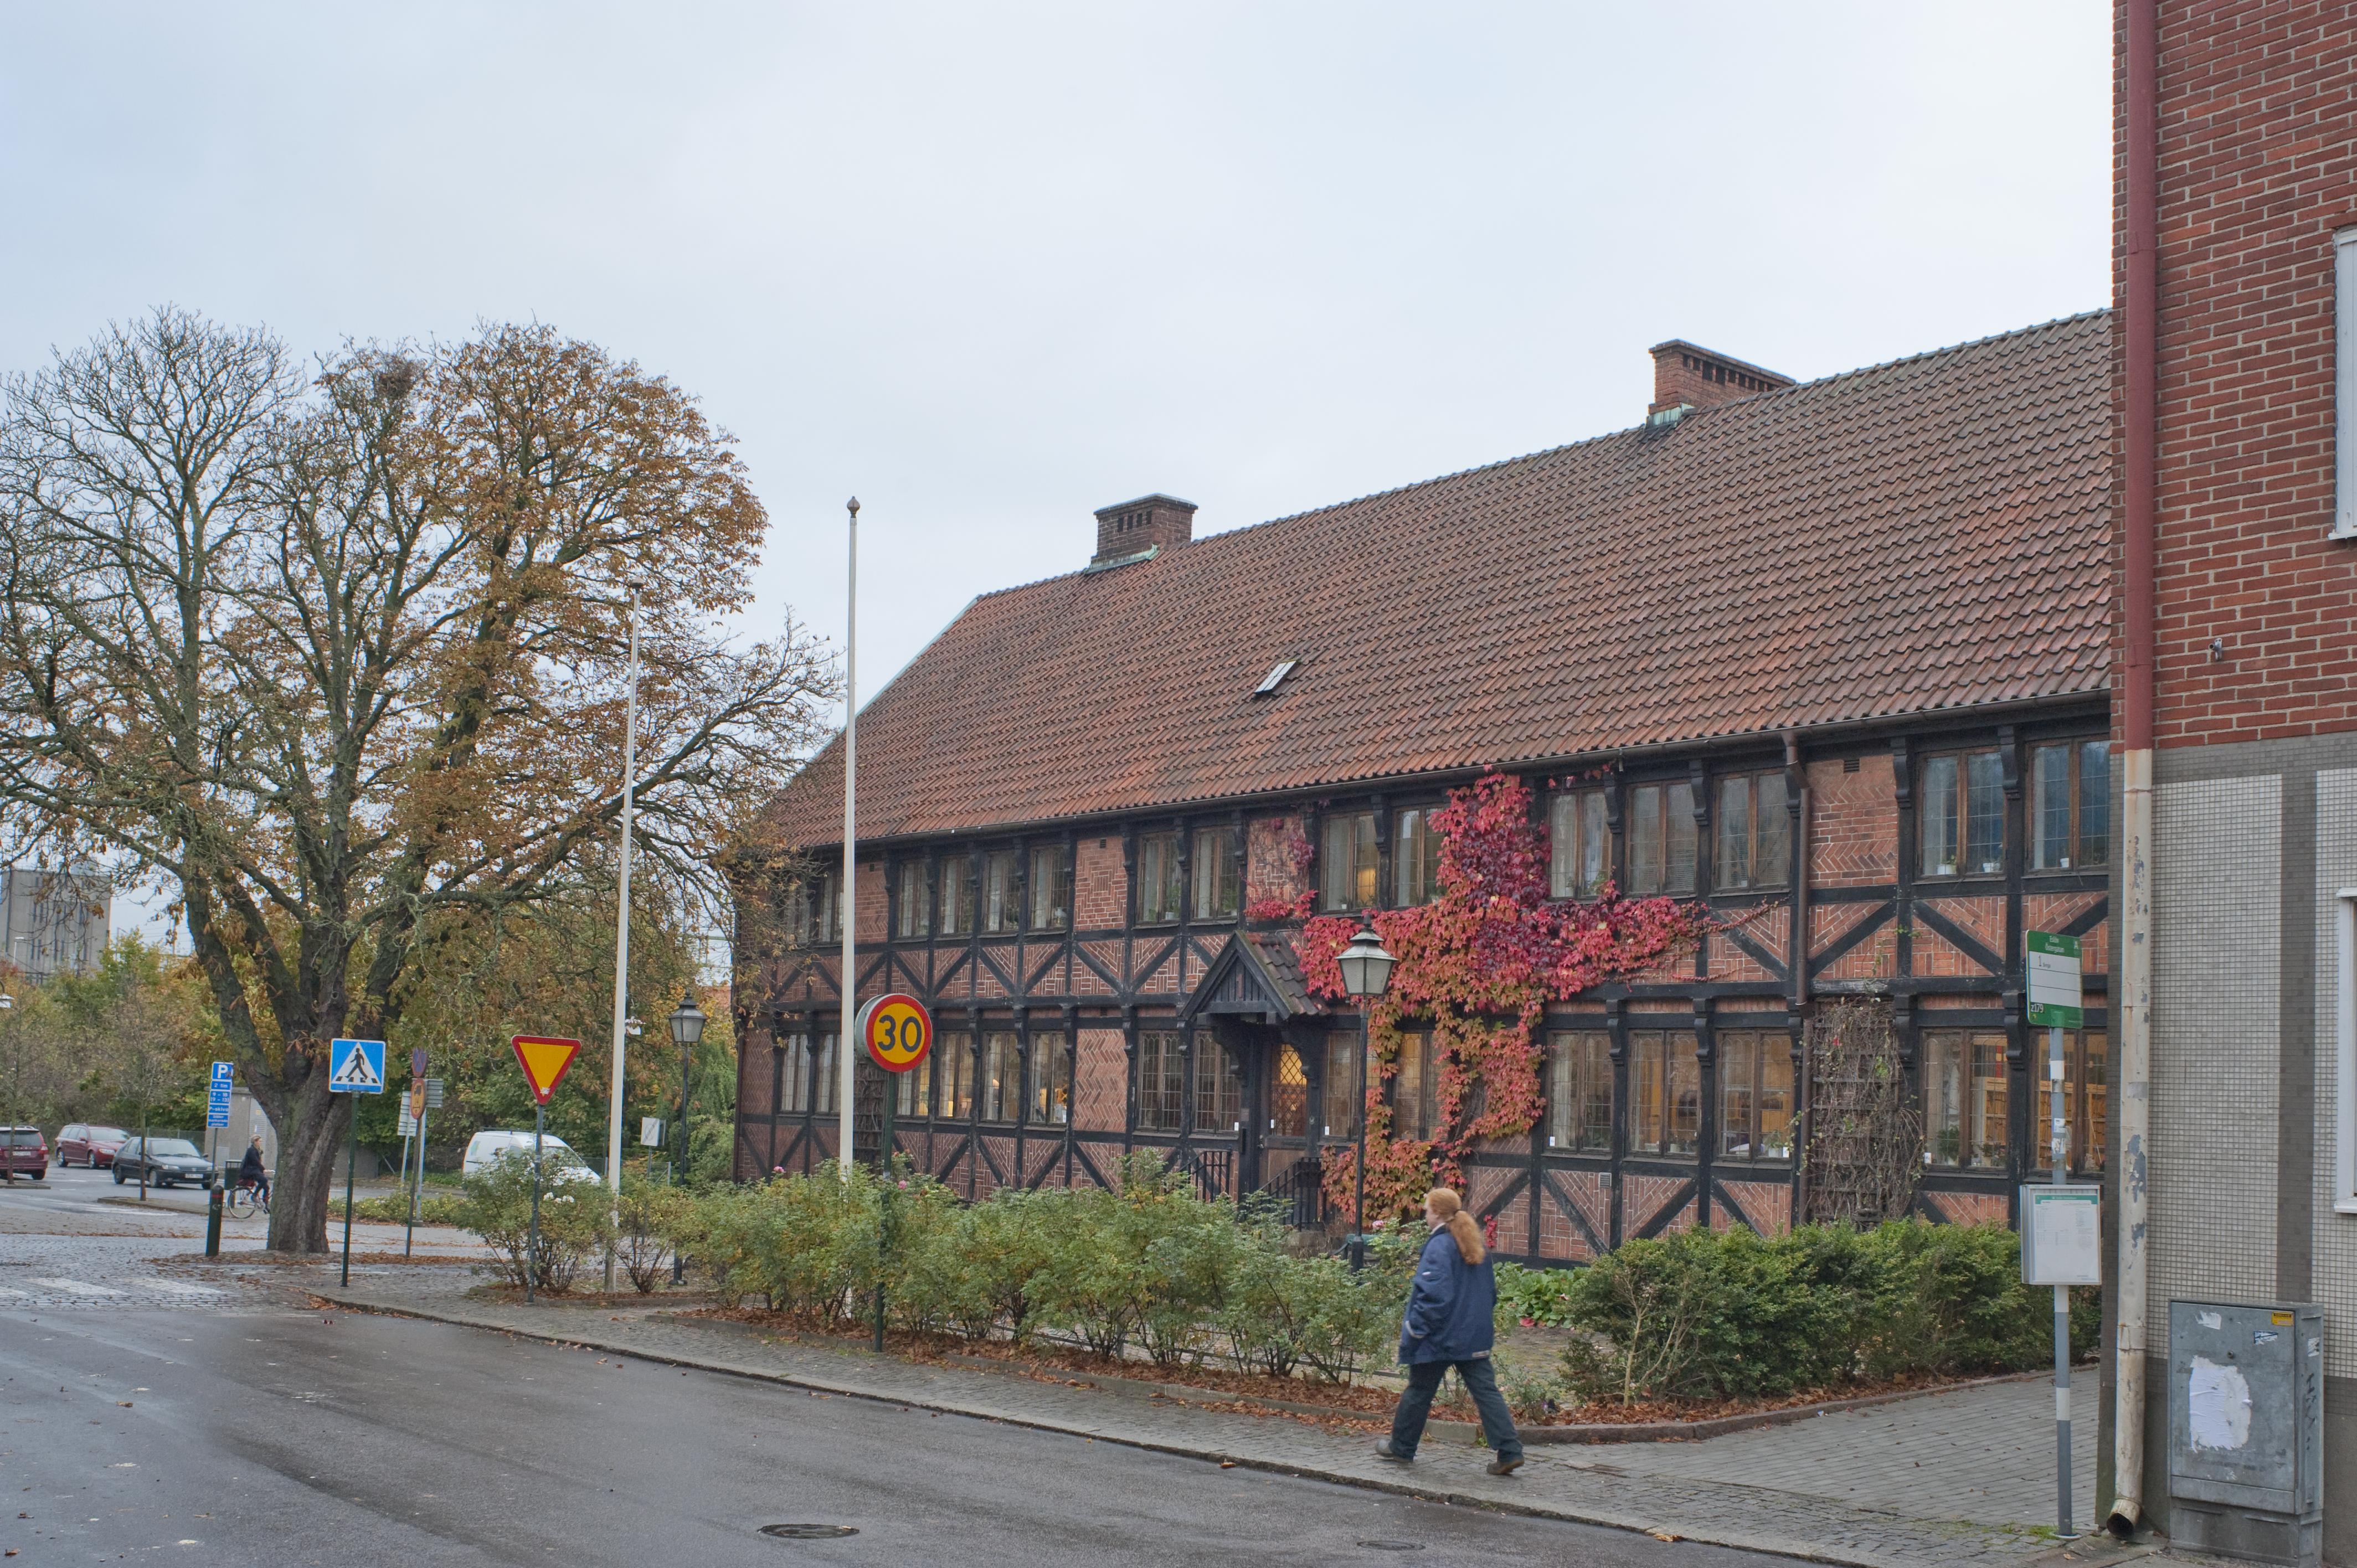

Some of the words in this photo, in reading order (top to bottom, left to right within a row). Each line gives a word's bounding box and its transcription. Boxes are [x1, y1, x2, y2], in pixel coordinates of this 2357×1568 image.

[2030, 1003, 2044, 1013] z179
[877, 1014, 922, 1053] 30
[217, 1064, 228, 1079] P
